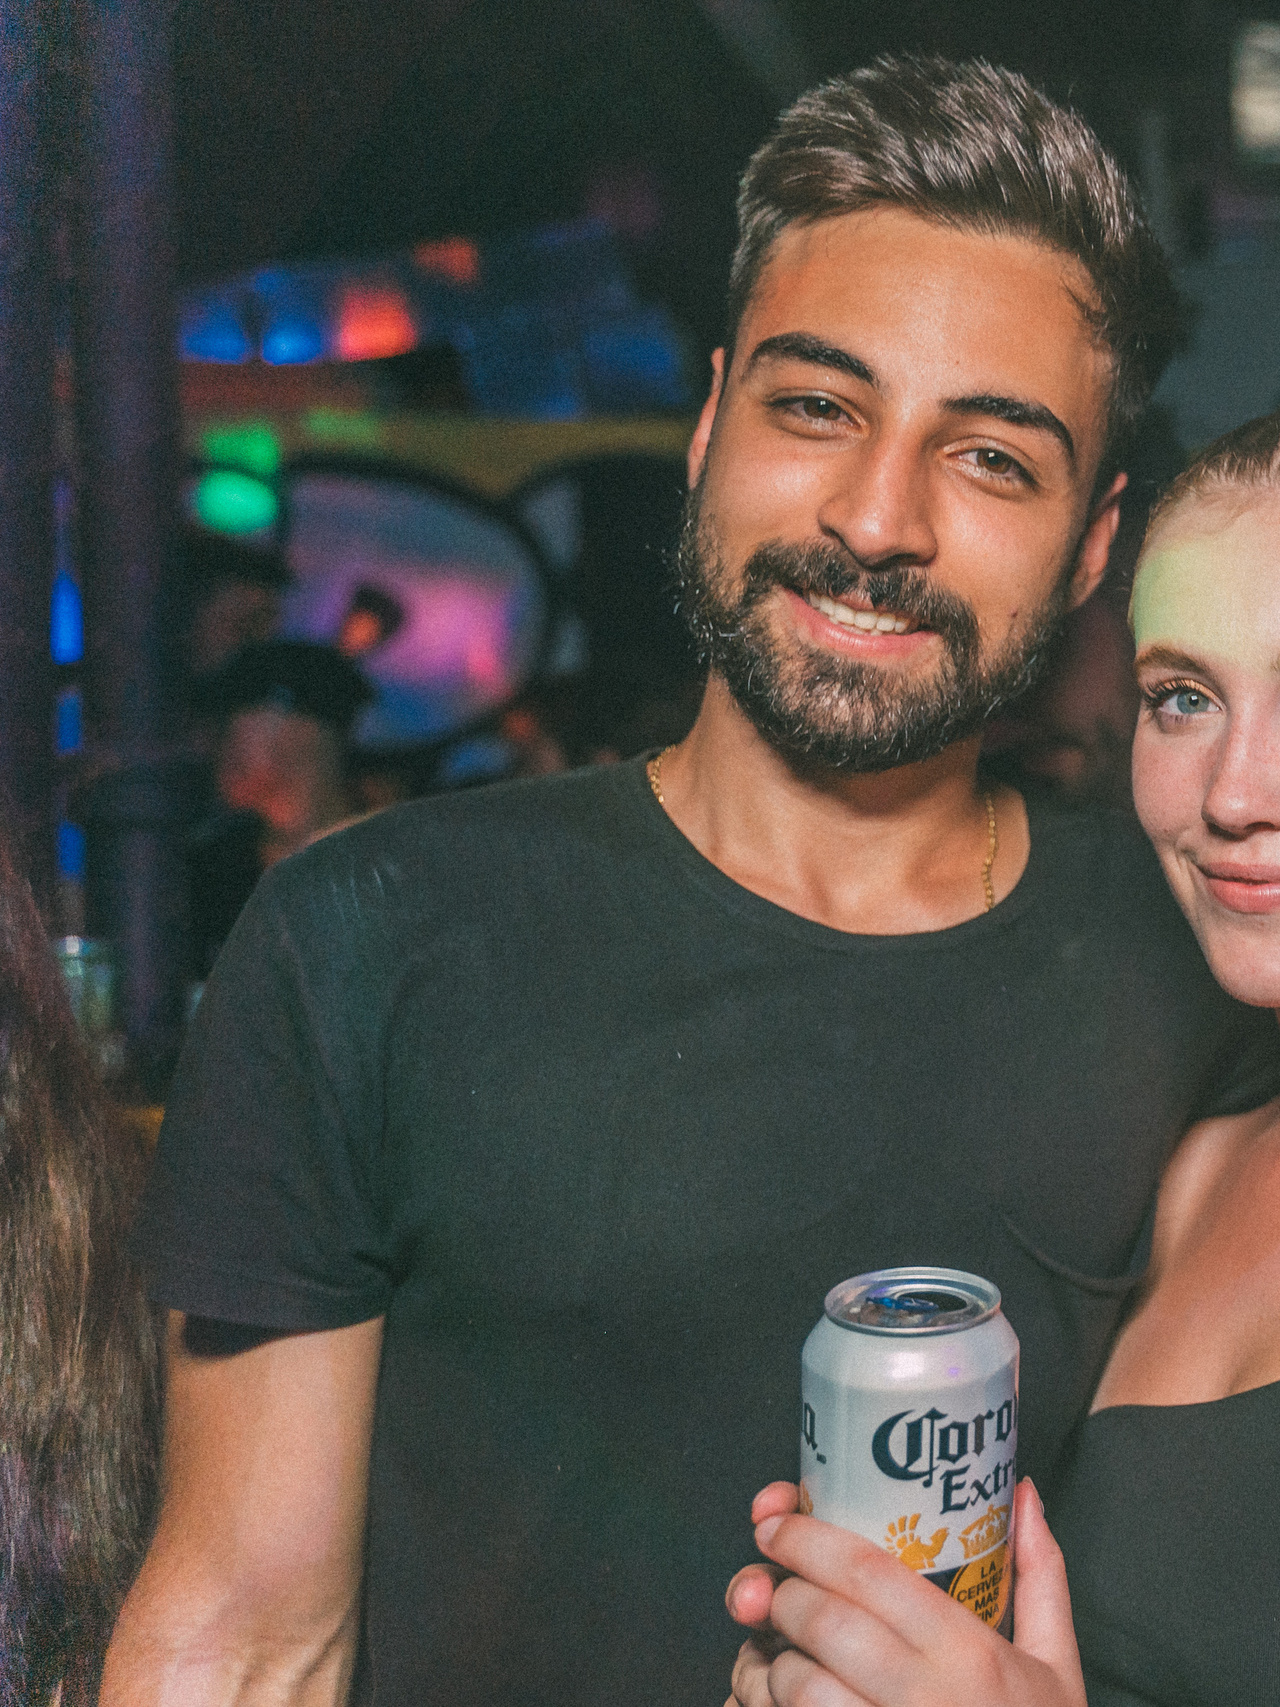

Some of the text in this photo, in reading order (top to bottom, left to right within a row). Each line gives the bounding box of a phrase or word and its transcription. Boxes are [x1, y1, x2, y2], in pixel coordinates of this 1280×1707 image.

[940, 1458, 1016, 1515] Extr
[981, 1561, 997, 1579] LA
[978, 1603, 1000, 1622] INA
